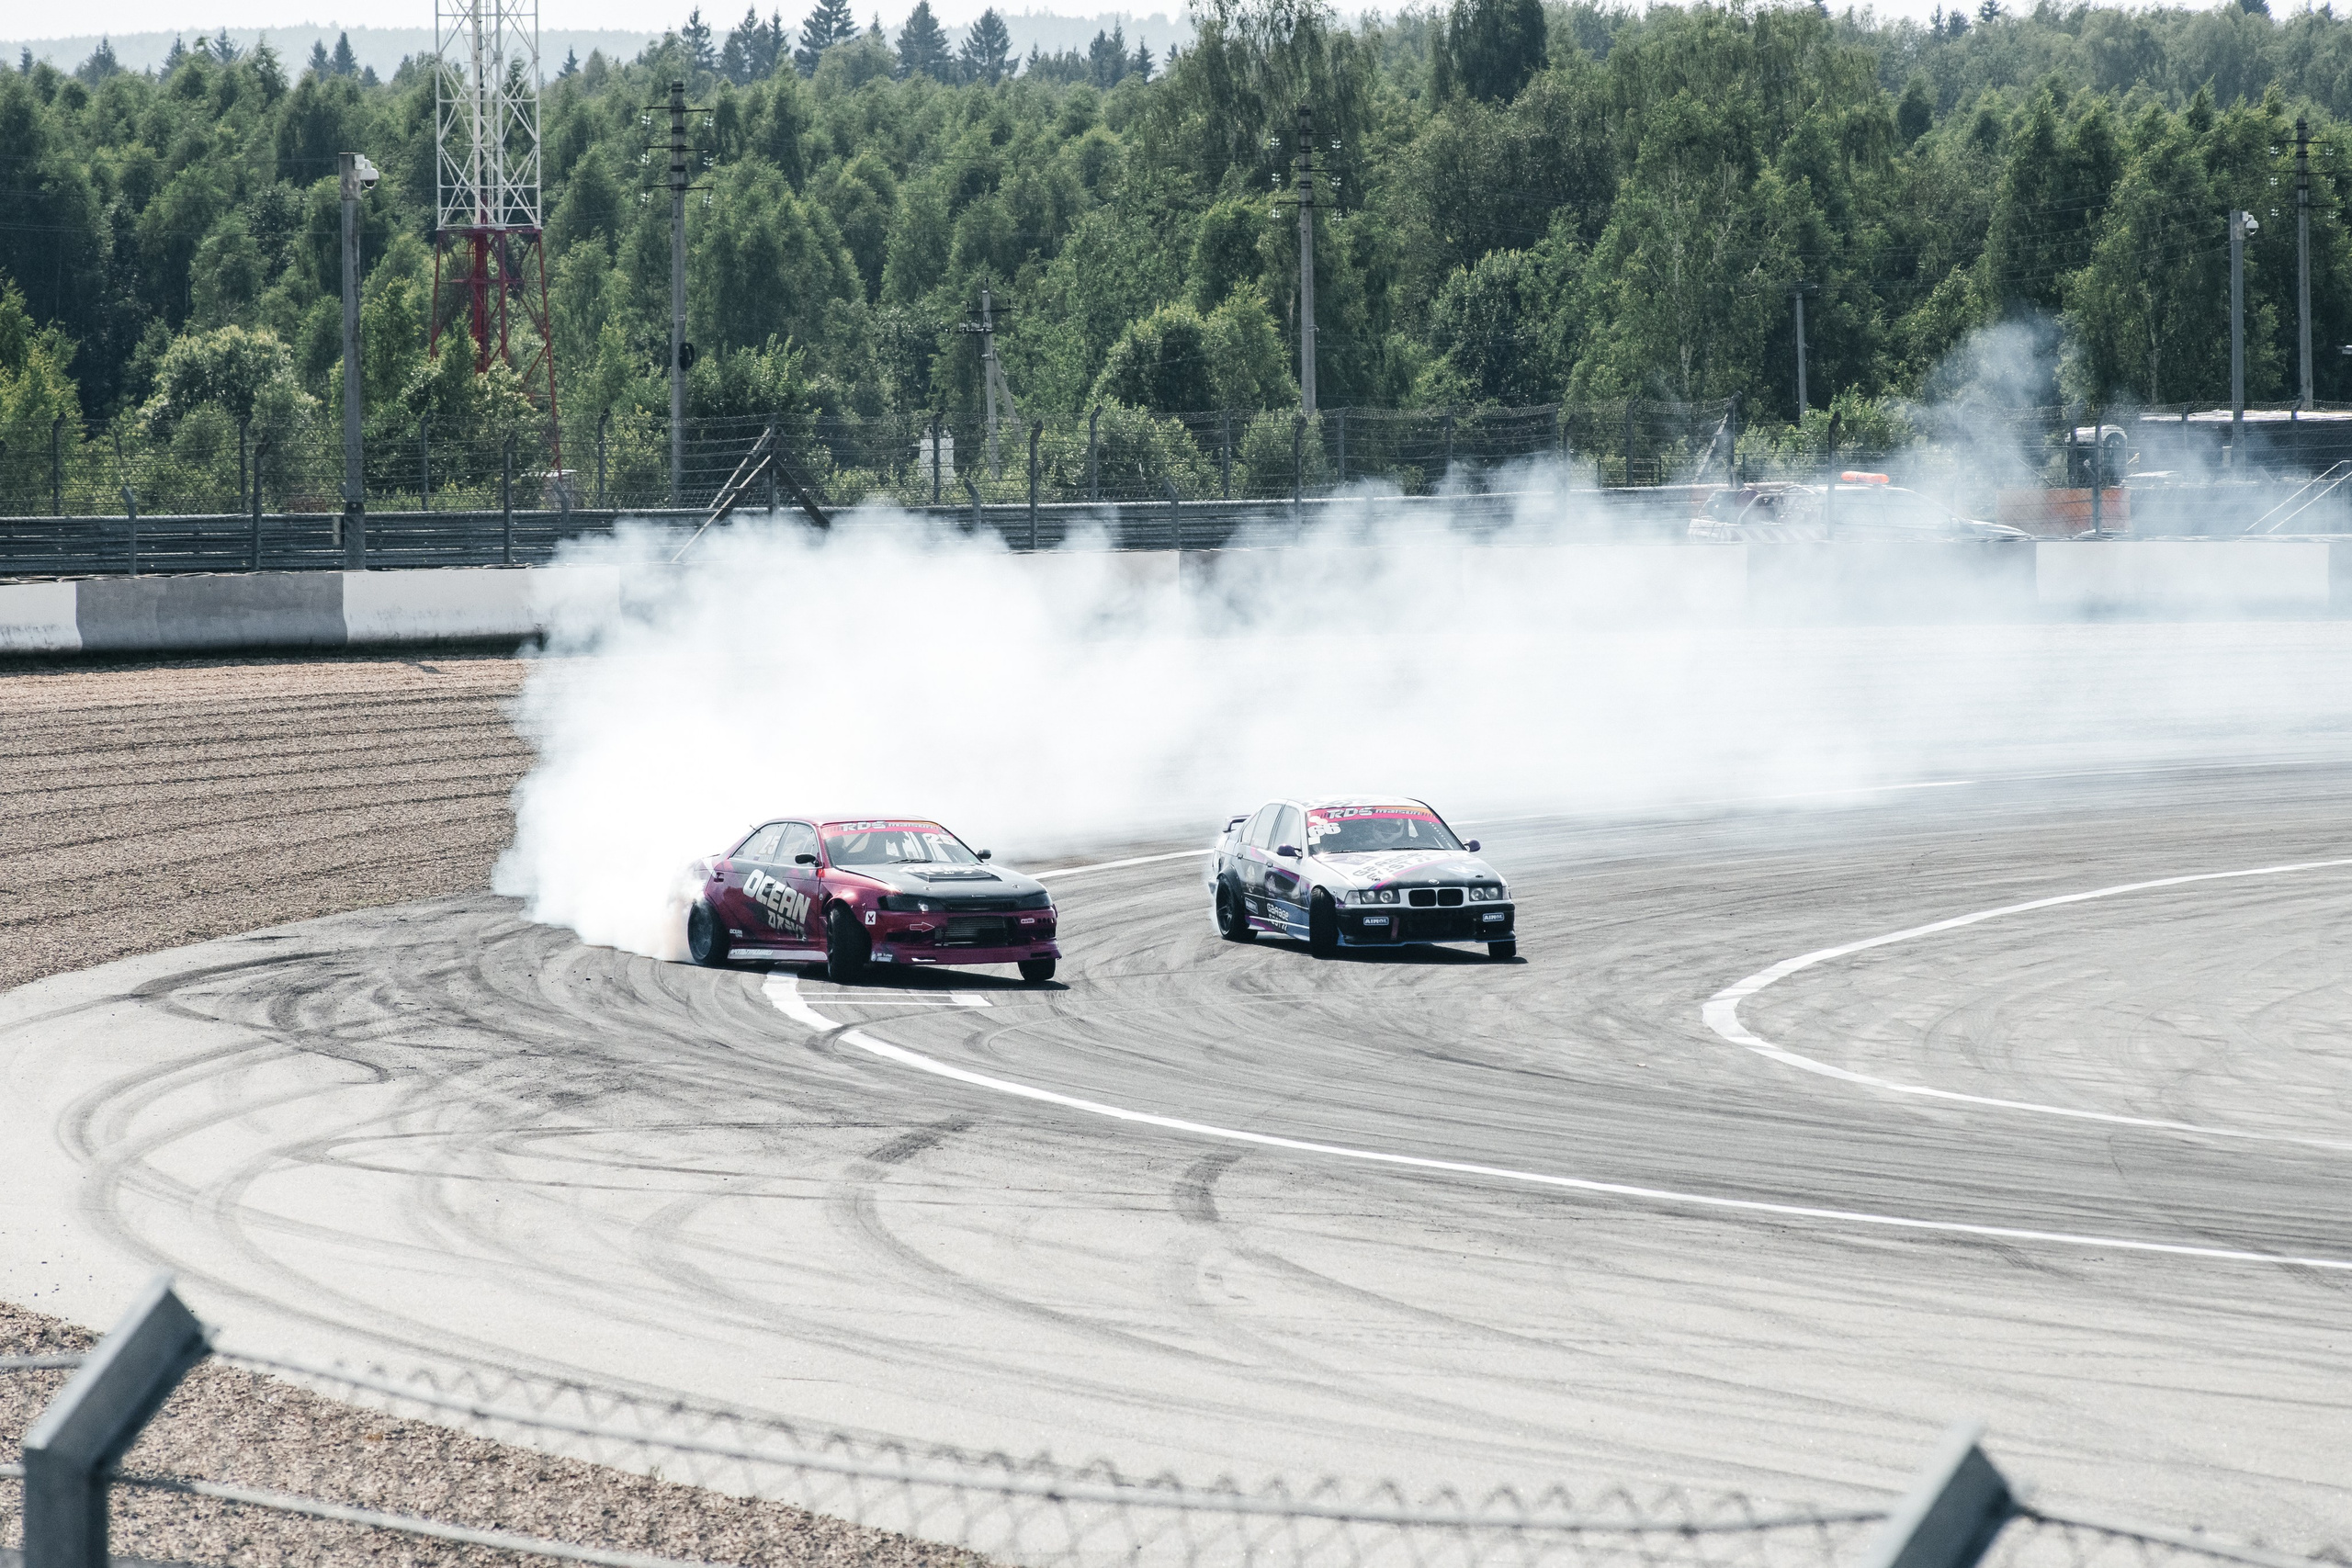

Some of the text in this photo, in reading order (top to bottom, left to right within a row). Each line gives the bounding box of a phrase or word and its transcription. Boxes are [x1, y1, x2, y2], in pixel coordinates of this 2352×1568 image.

[1327, 807, 1374, 818] RDS
[842, 821, 886, 831] RDS
[1307, 823, 1341, 837] 66
[758, 835, 780, 855] 25
[922, 833, 957, 846] 25
[742, 869, 810, 924] OCEAN
